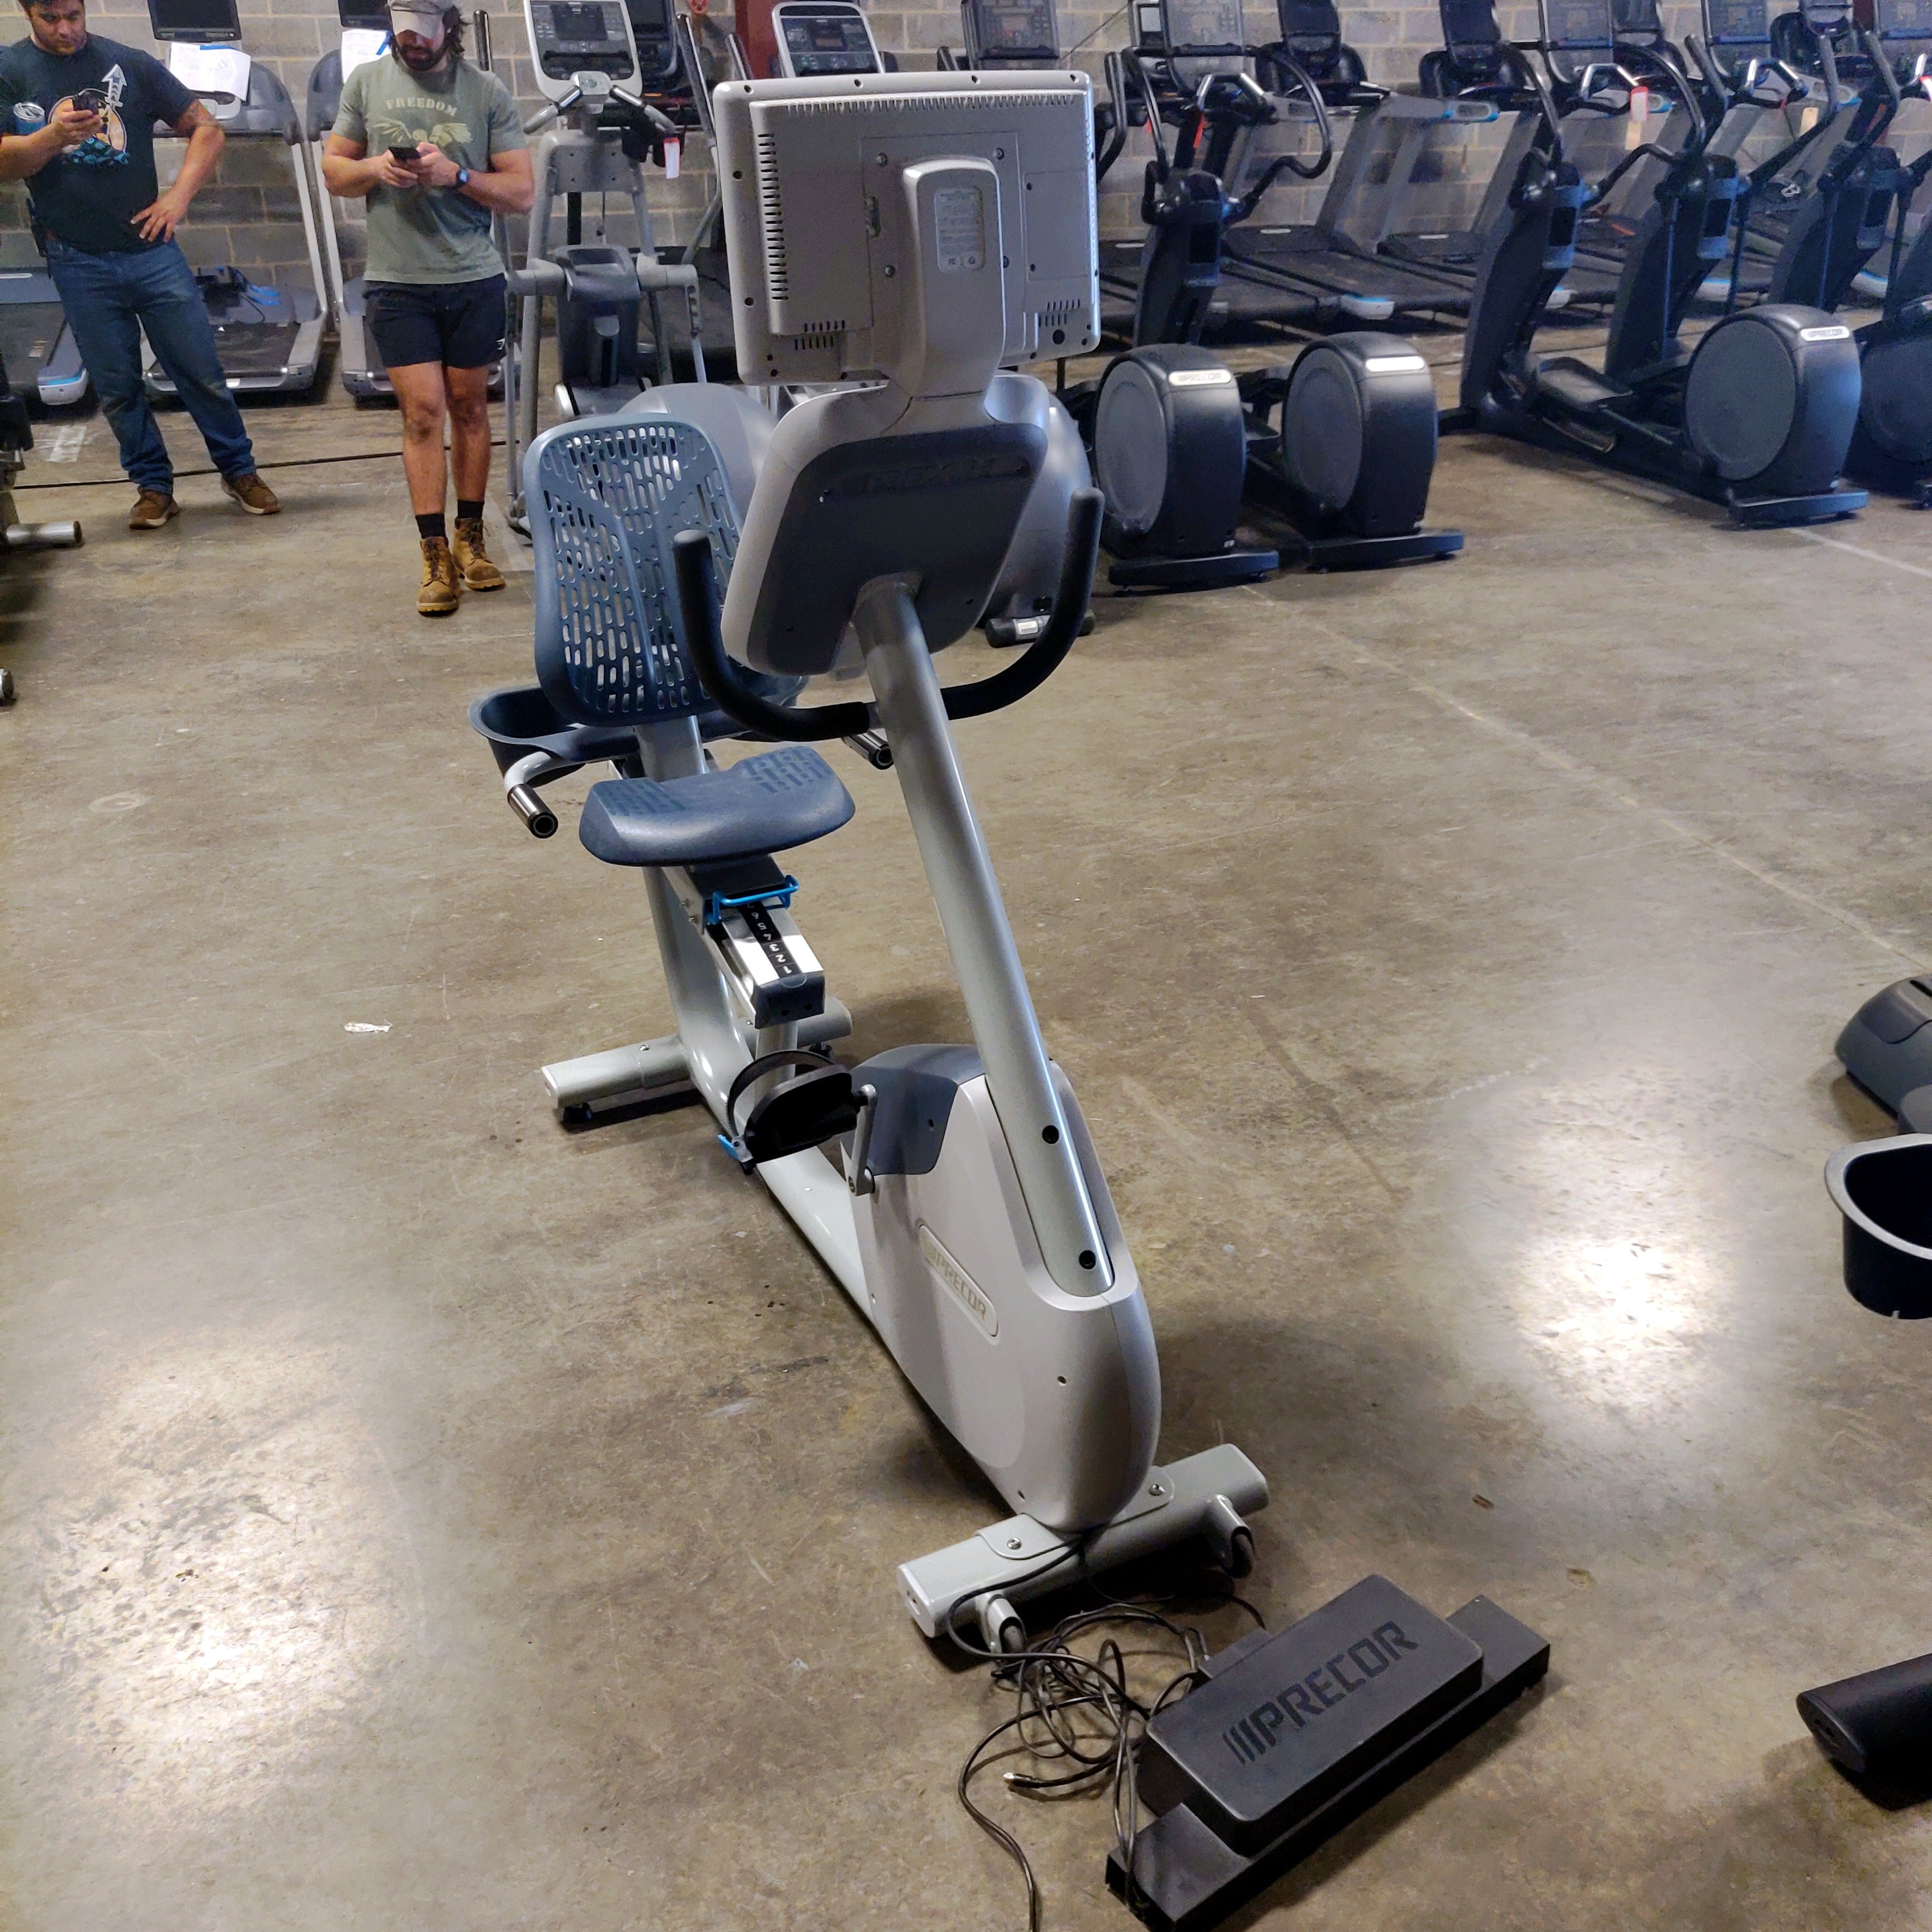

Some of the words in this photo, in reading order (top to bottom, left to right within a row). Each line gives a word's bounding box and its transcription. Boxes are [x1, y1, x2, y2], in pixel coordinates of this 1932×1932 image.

[386, 97, 458, 117] FREEDOM
[769, 943, 780, 952] 3
[775, 954, 787, 963] 2
[783, 965, 792, 974] 1
[935, 1250, 987, 1320] PRECOR
[1248, 1621, 1419, 1748] PRECOR
